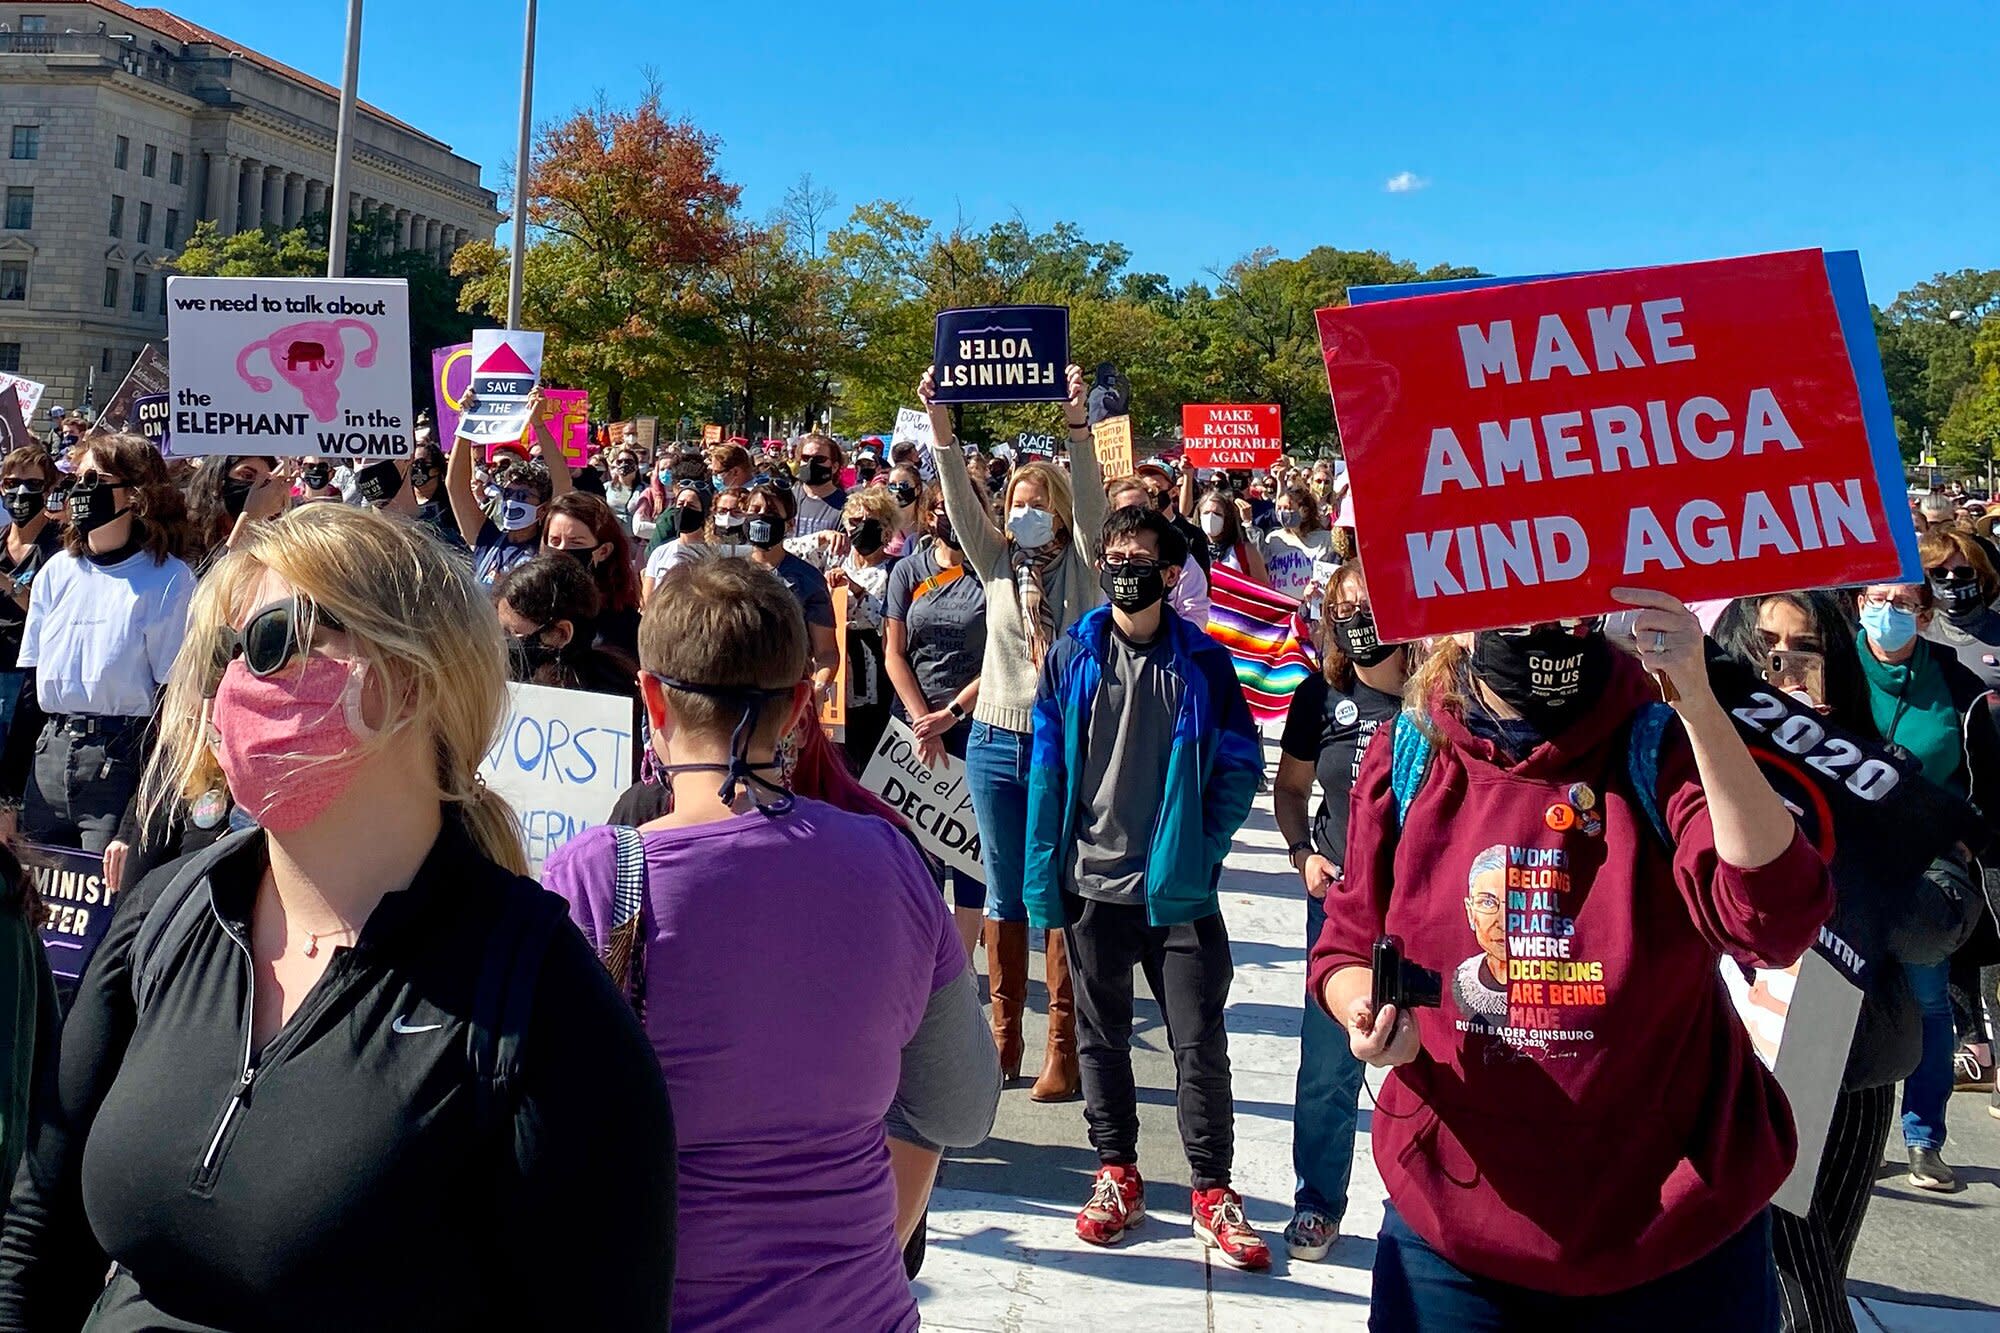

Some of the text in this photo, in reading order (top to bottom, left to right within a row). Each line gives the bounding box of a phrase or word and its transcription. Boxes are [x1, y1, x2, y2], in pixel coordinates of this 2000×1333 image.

[175, 294, 385, 315] we need to talk about
[959, 338, 1033, 360] VOTER
[1457, 297, 1696, 390] MAKE
[940, 362, 1055, 387] FEMINIST
[177, 388, 211, 406] the
[487, 382, 517, 393] SAVE
[140, 402, 169, 419] COU
[344, 409, 401, 428] in the
[488, 403, 512, 413] THE
[1209, 410, 1254, 421] MAKE
[144, 421, 162, 437] ON
[176, 411, 310, 435] ELEPHANT
[1203, 424, 1260, 435] RACISM
[317, 433, 409, 456] WOMB
[1018, 433, 1055, 450] RAGE
[1184, 437, 1281, 449] DEPLORABLE
[1421, 388, 1803, 496] AMERICA
[1100, 446, 1124, 463] OUT
[1208, 452, 1256, 463] AGAIN
[1104, 460, 1131, 478] OW!
[1406, 479, 1878, 599] KIND AGAIN
[1112, 577, 1139, 586] COUNT
[1114, 585, 1124, 593] ON
[1347, 626, 1374, 638] COUNT
[1351, 635, 1376, 647] ON US
[1528, 652, 1584, 672] COUNT
[1531, 670, 1580, 685] ON US
[1359, 720, 1378, 733] THIS
[1731, 691, 1900, 801] 2020
[933, 775, 963, 800] el
[881, 776, 985, 866] DECIDA
[522, 810, 590, 862] ERN
[20, 864, 111, 907] MINIST
[1508, 868, 1571, 893] BELONG
[1508, 890, 1561, 913] IN ALL
[46, 904, 89, 937] TER
[1508, 914, 1576, 936] PLACES
[1508, 936, 1571, 958] WHERE
[1818, 925, 1866, 975] NTRY
[1509, 959, 1604, 982] DECISIONS
[1511, 983, 1607, 1006] ARE BEING
[1509, 1007, 1561, 1028] MADE
[1455, 1020, 1595, 1041] RUTH BADER GINSBURG
[1502, 1037, 1546, 1048] 1933-2020
